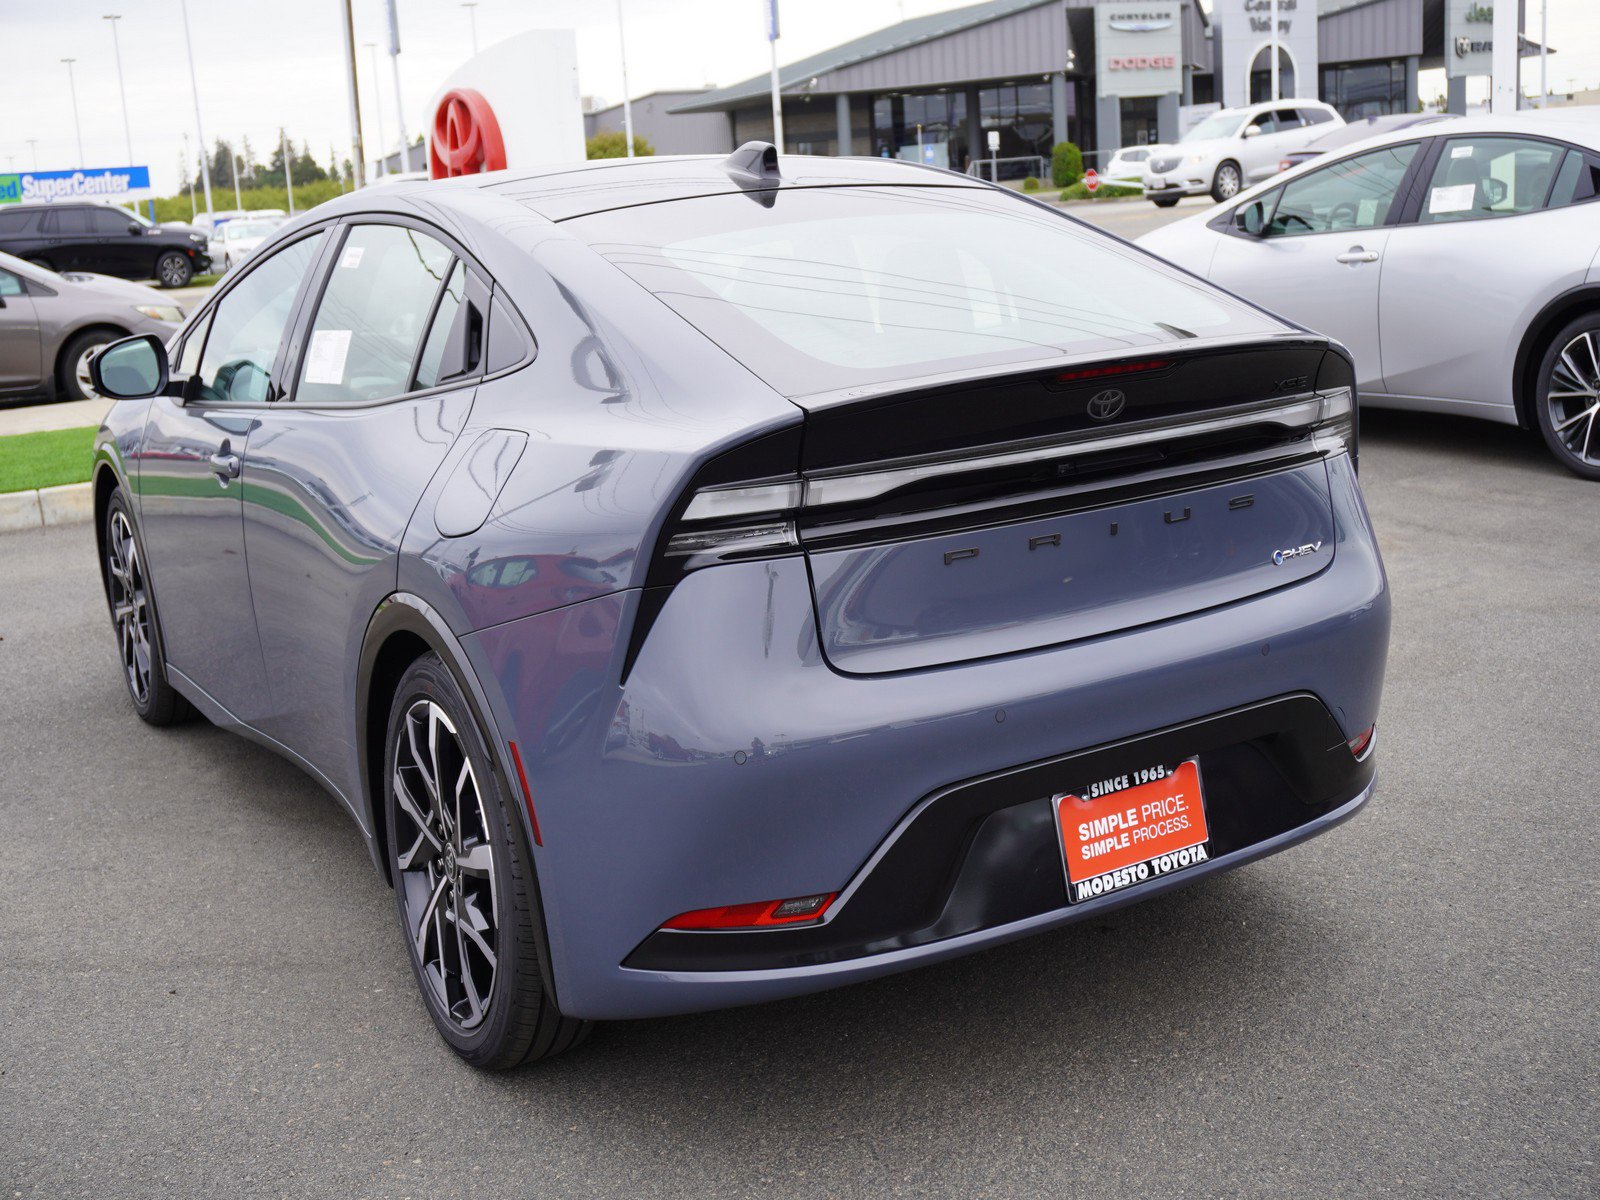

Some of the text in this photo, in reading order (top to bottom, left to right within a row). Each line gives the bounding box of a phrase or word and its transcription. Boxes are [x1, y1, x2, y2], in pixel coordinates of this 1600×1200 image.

[1244, 0, 1297, 11] Cenral
[1465, 2, 1493, 23] Jee
[1249, 16, 1292, 34] Valey
[1471, 42, 1493, 52] RA
[1108, 56, 1174, 71] DODGE
[21, 171, 130, 203] SuperCenter
[1272, 376, 1308, 393] XSE
[944, 493, 1255, 565] PRIUS
[1282, 541, 1322, 560] PHEV
[1090, 765, 1166, 798] SINCE 1965
[1078, 794, 1189, 841] SIMPLE PRICE.
[1081, 815, 1192, 860] SIMPLE PROCESS.
[1077, 844, 1208, 900] MODESTO TOYOTA
